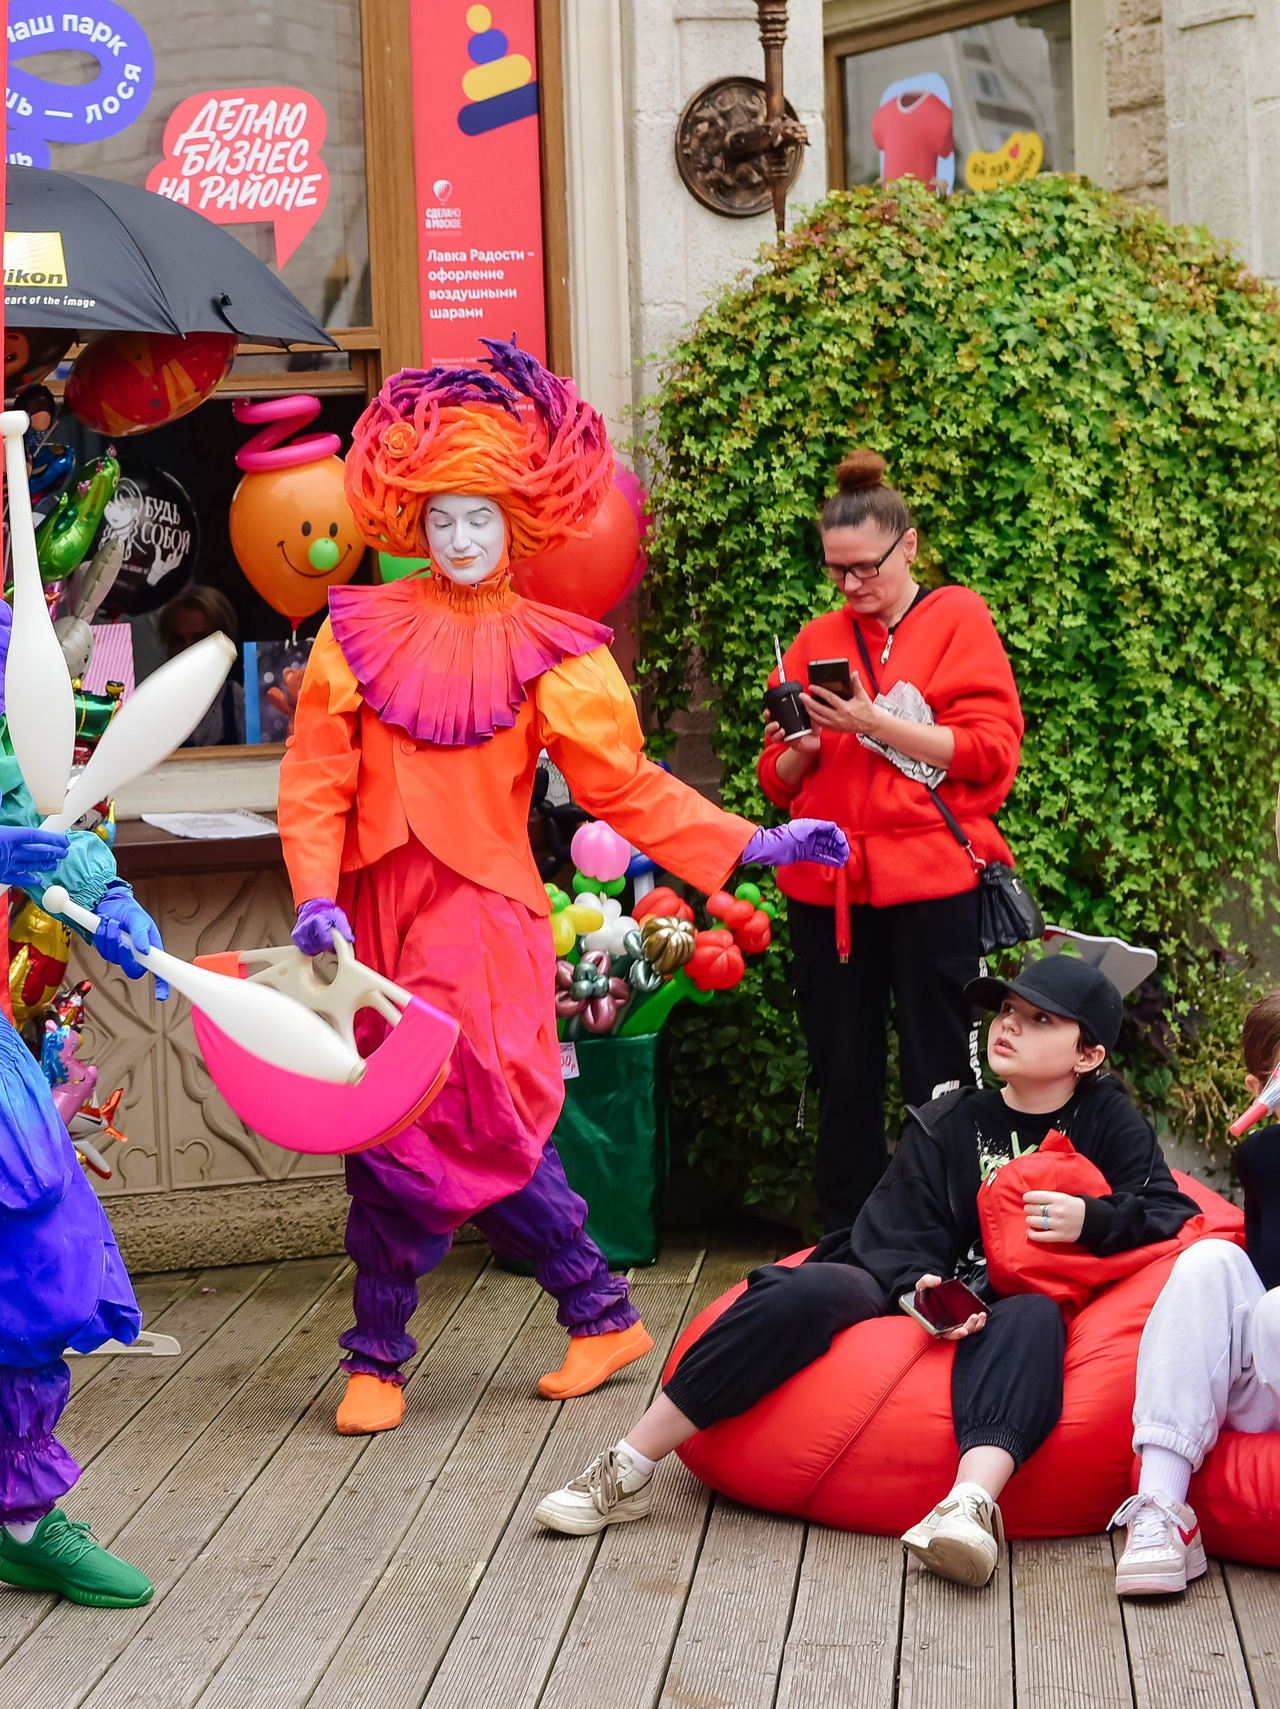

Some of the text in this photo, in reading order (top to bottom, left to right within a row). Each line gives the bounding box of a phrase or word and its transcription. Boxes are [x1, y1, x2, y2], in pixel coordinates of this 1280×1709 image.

[62, 14, 128, 57] парк
[85, 63, 142, 124] лося
[172, 98, 308, 156] ДЕЛАЮ
[181, 137, 310, 177] БИЗНЕС
[157, 173, 322, 211] НА РАЙОНЕ
[427, 249, 467, 263] Лавка
[470, 248, 525, 264] Радости
[4, 269, 63, 284] ikon
[428, 267, 505, 284] офорление
[4, 294, 96, 309] eart of the image
[429, 288, 518, 303] воздушными
[429, 307, 483, 321] шарами
[145, 496, 181, 526] БУДЬ
